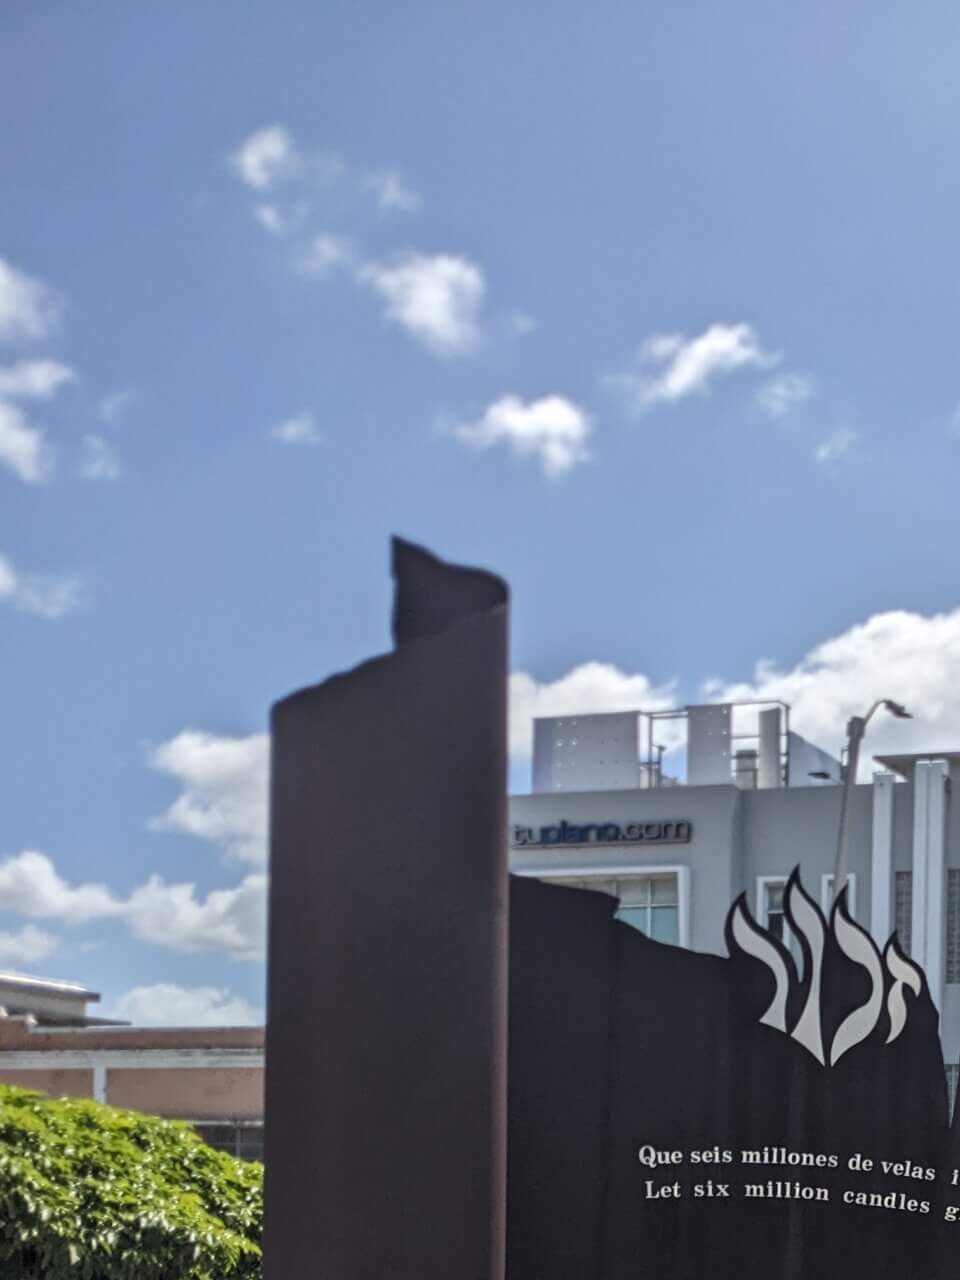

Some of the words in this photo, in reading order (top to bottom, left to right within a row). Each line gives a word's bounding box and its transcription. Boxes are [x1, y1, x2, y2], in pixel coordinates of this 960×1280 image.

[638, 1145, 683, 1169] Que
[690, 1145, 733, 1164] seis
[741, 1146, 839, 1168] millones
[847, 1153, 874, 1172] de
[880, 1160, 936, 1181] velas
[645, 1180, 681, 1199] Let
[693, 1179, 729, 1198] six
[744, 1180, 829, 1201] million
[843, 1190, 930, 1214] candles
